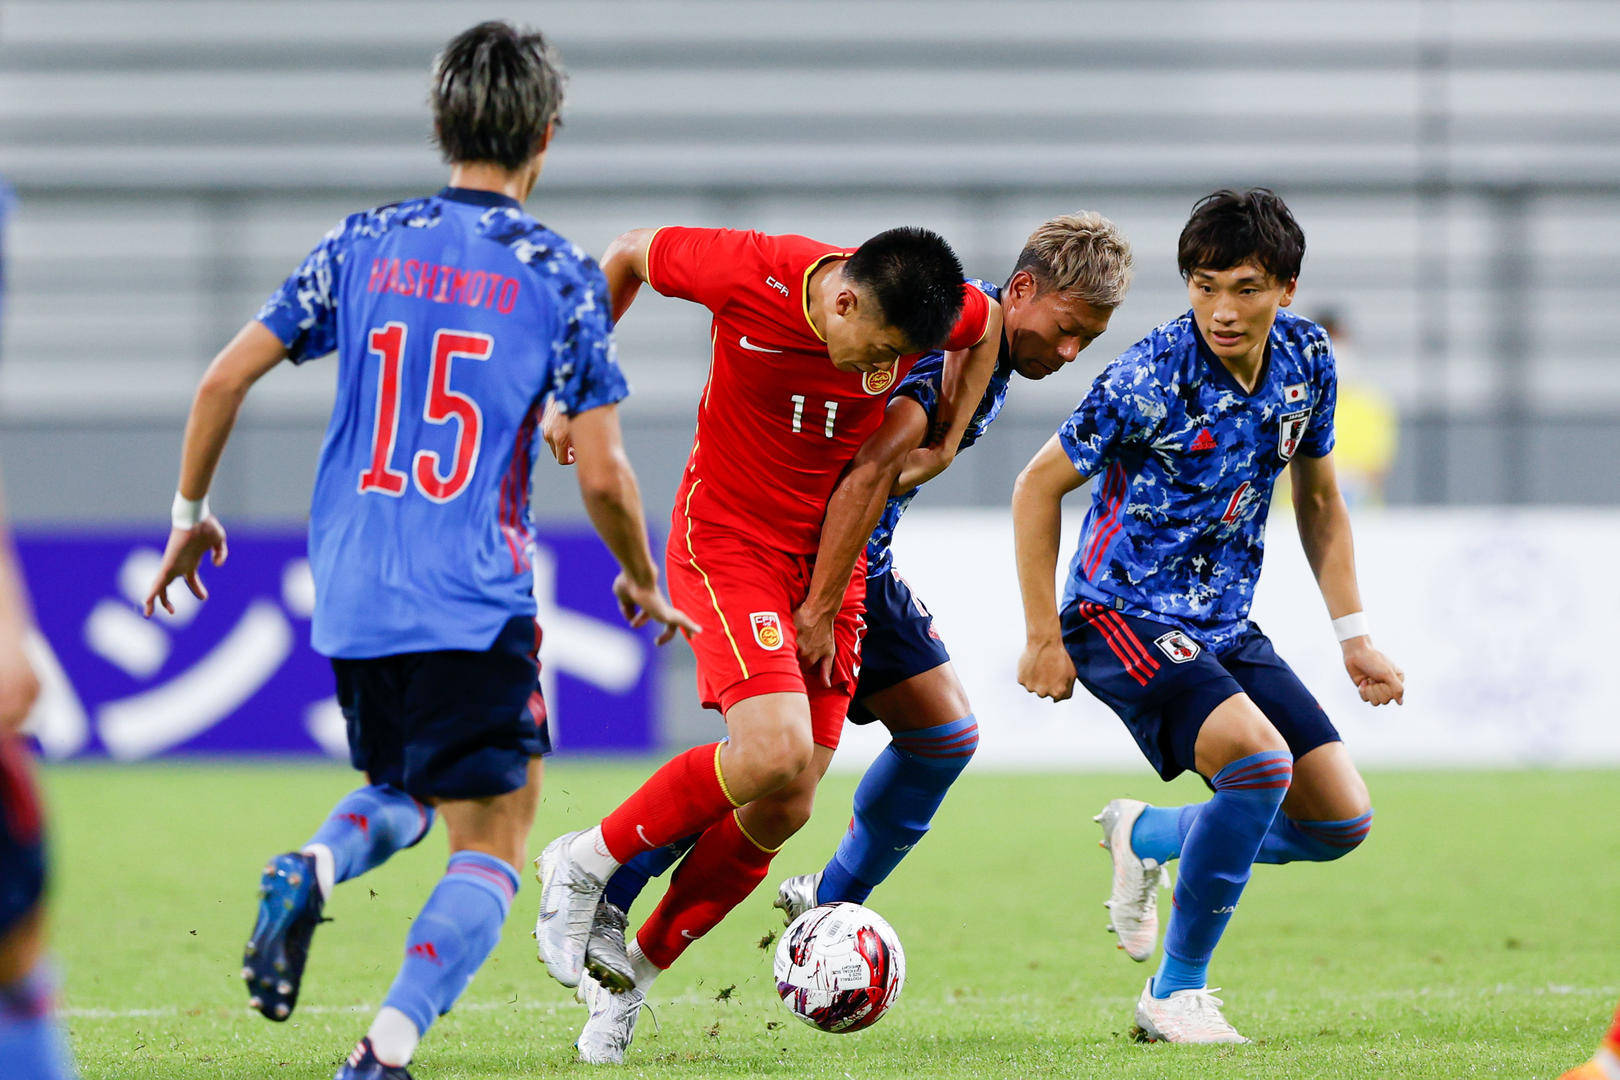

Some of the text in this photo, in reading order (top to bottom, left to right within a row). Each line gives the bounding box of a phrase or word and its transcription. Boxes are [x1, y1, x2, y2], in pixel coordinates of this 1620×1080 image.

[367, 258, 520, 315] HASHIMOTO
[765, 275, 789, 297] CFA
[357, 320, 494, 504] 15
[791, 394, 838, 438] 11
